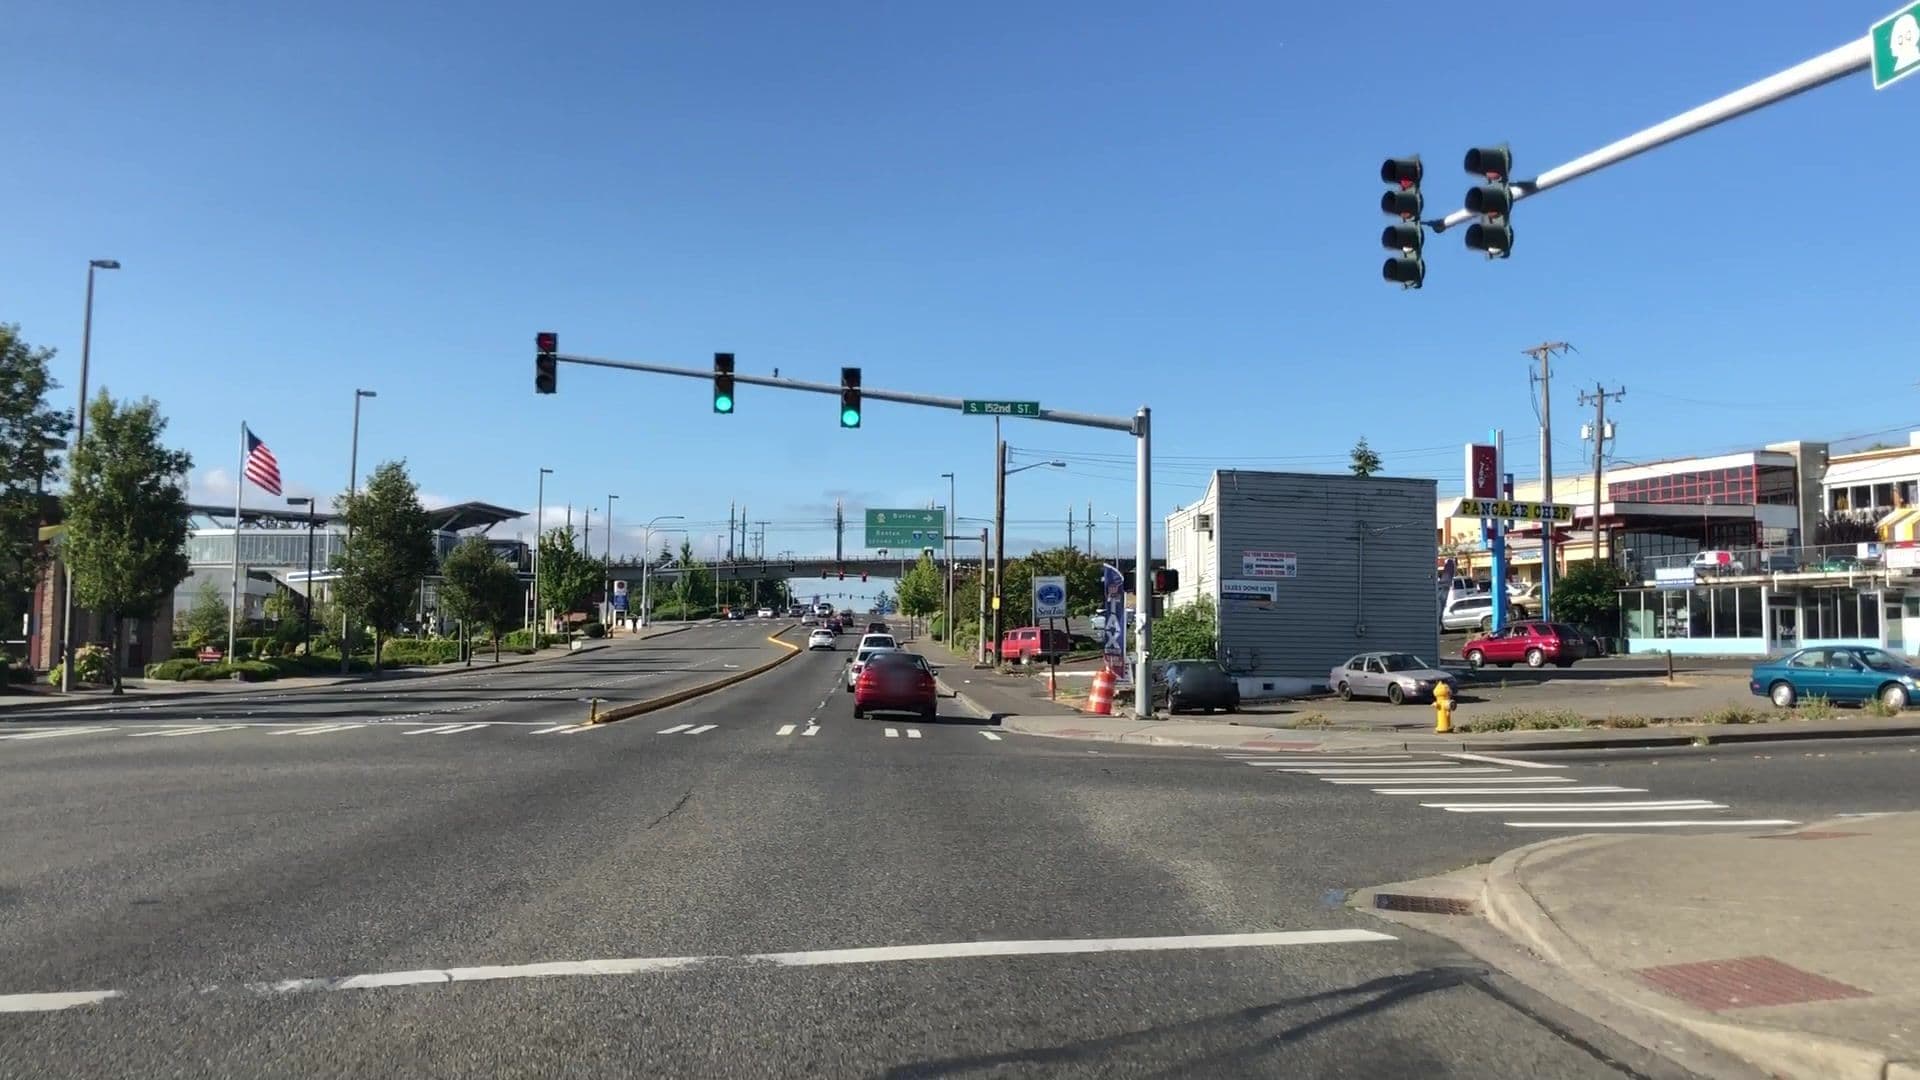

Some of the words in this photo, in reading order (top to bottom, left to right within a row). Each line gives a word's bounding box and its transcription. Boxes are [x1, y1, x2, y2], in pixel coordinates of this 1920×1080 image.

[984, 403, 1011, 413] 152nd
[1462, 501, 1529, 517] PANCAKE
[1534, 505, 1570, 519] CHEF
[1260, 585, 1275, 593] HERE
[1105, 593, 1121, 649] TAX
